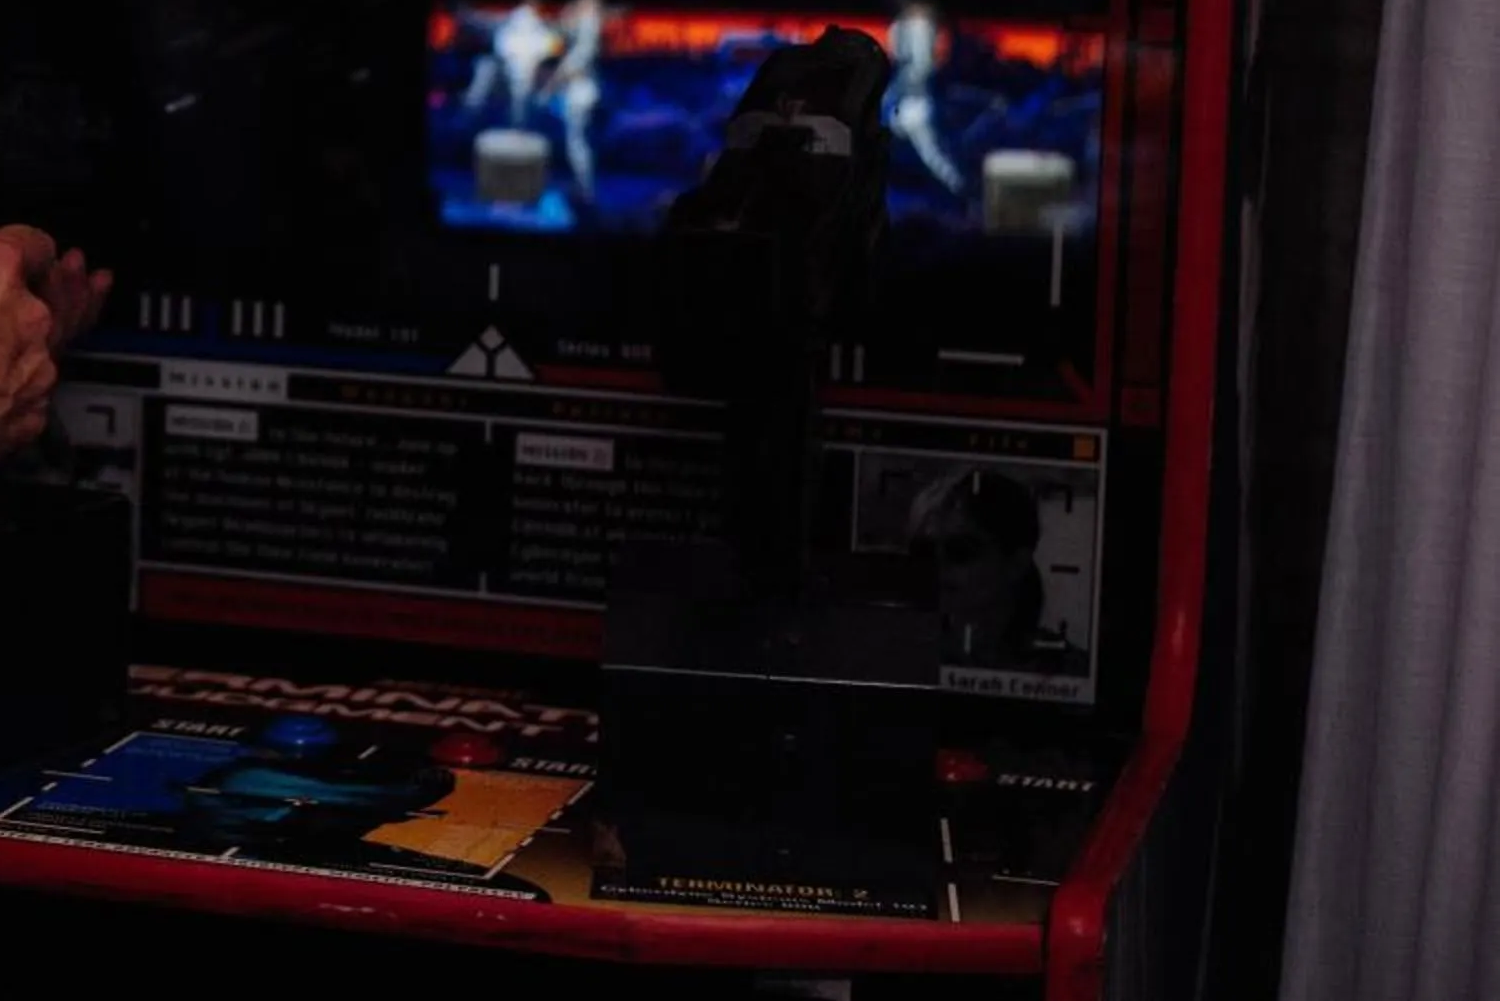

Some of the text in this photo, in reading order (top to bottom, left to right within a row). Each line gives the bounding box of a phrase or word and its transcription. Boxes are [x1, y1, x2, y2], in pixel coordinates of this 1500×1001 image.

[948, 672, 1003, 691] Sarah
[151, 718, 246, 738] START
[508, 755, 597, 775] STAR
[996, 773, 1097, 792] START
